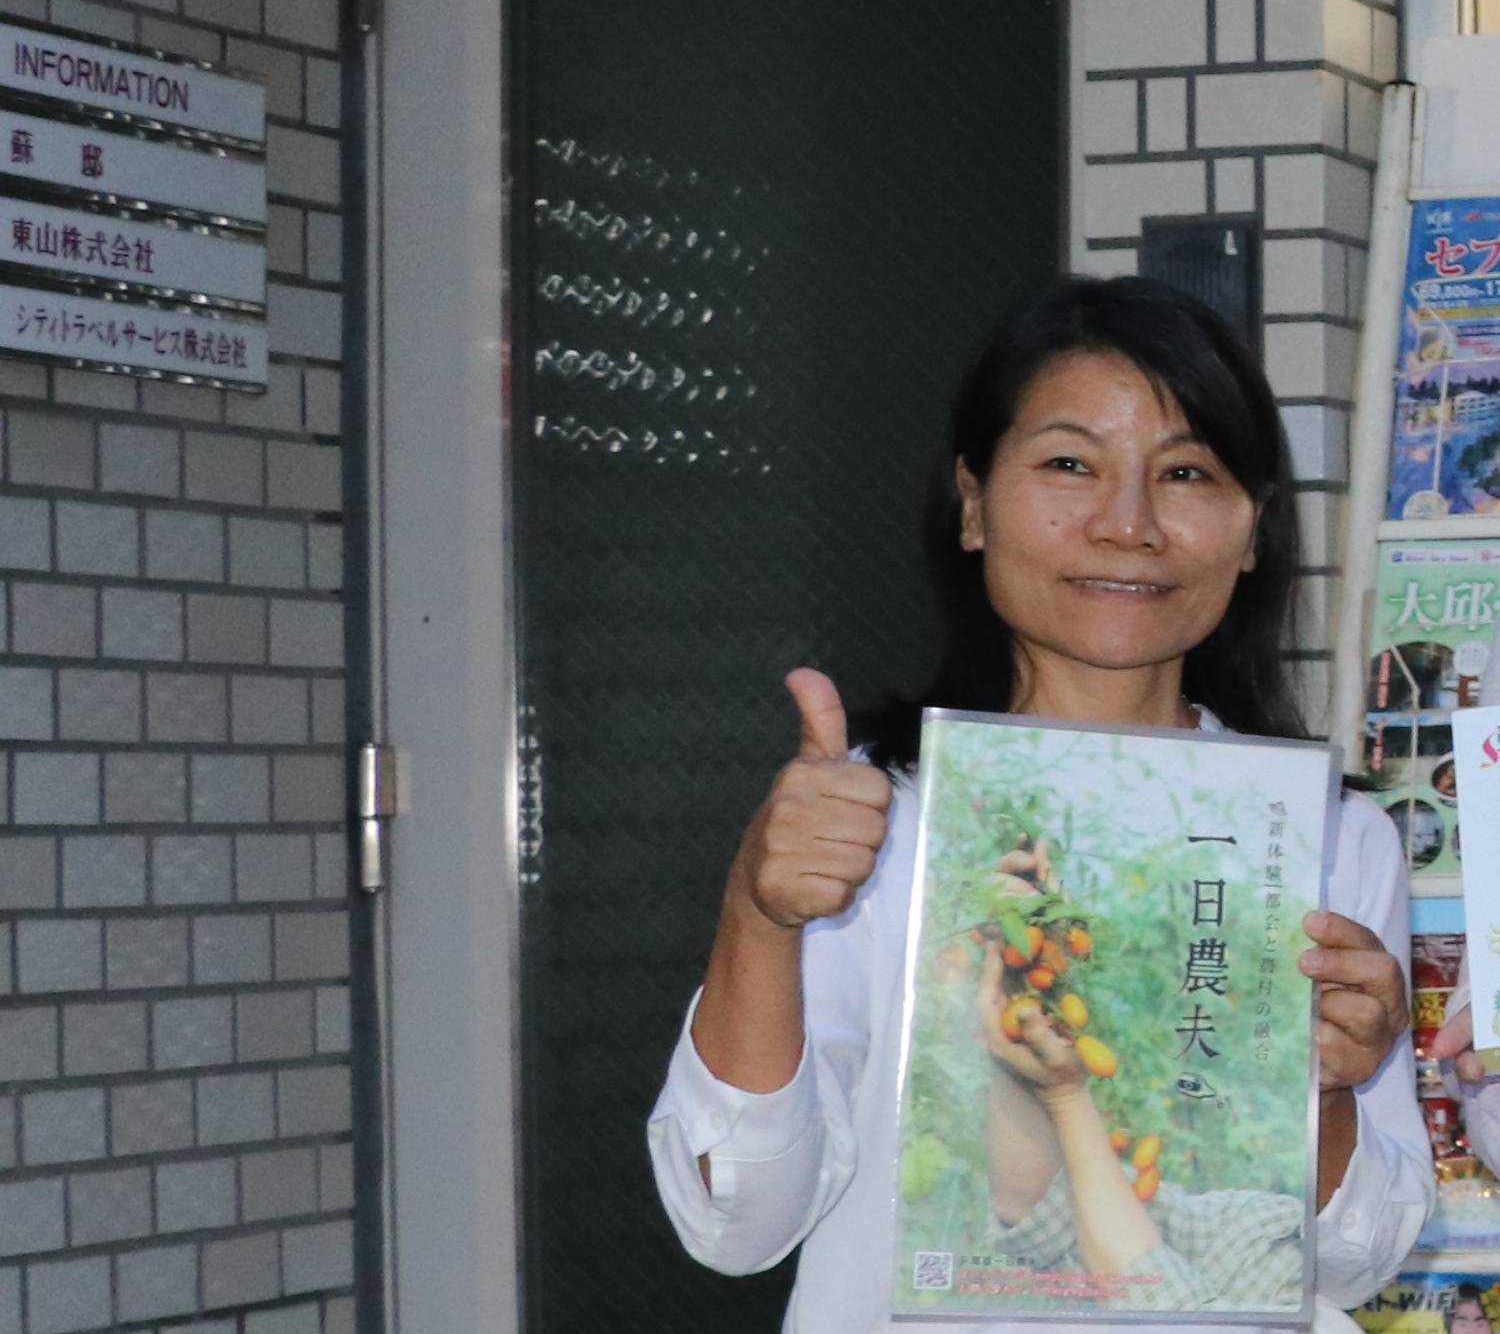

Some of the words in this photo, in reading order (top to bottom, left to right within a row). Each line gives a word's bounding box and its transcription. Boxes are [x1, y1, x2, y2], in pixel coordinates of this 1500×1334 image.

[14, 43, 189, 112] INFORMATION
[11, 218, 155, 274] 東山株式会社
[15, 304, 248, 367] シティトラベルサービス株式会社
[1173, 834, 1237, 1060] 一日農夫
